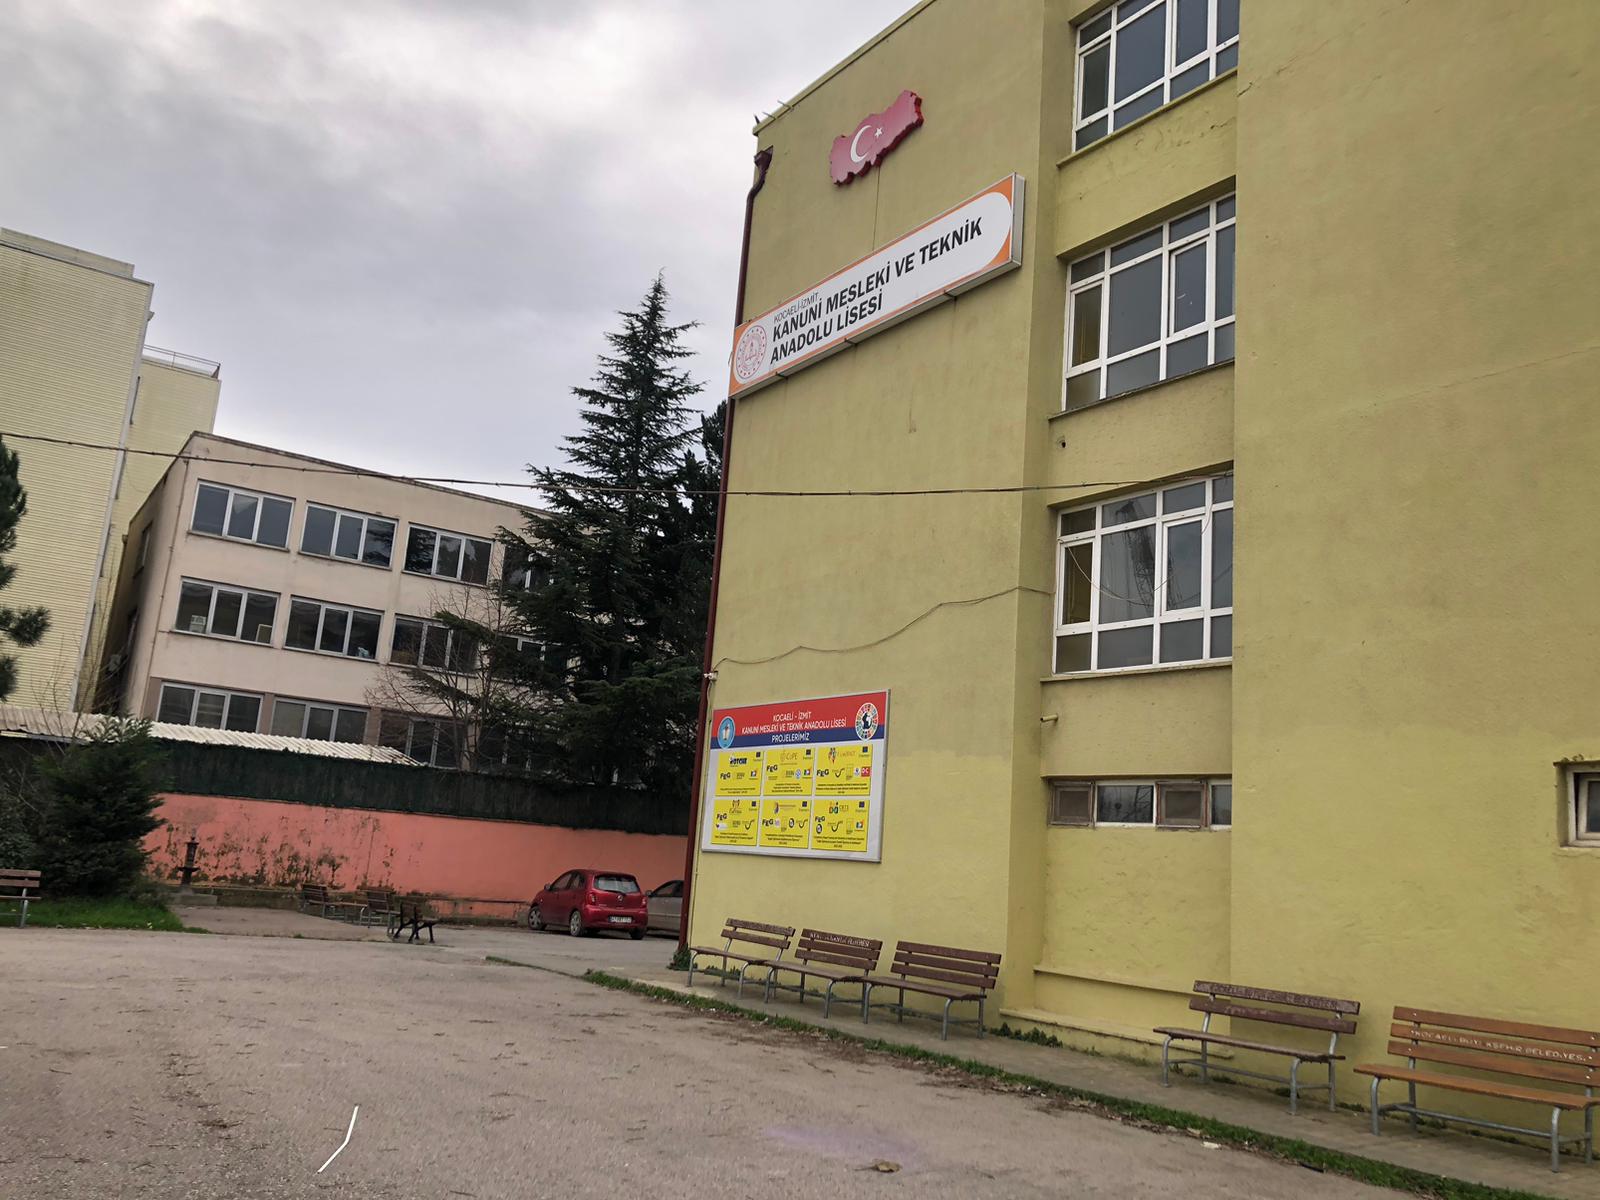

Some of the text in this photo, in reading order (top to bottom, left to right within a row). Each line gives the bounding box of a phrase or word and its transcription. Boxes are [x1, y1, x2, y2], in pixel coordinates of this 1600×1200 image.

[773, 217, 982, 342] KANUNİ MESLEKİ VE TEKNİK
[770, 288, 883, 364] ANADOLU LİSESİ
[798, 710, 812, 719] İZMİT
[759, 722, 779, 733] MESLEKİ
[779, 723, 786, 731] VE
[786, 721, 804, 731] TEKNİK
[804, 720, 830, 730] ANADOLU
[830, 717, 847, 728] LİSESİ
[771, 731, 810, 743] PROJELERİMİZ
